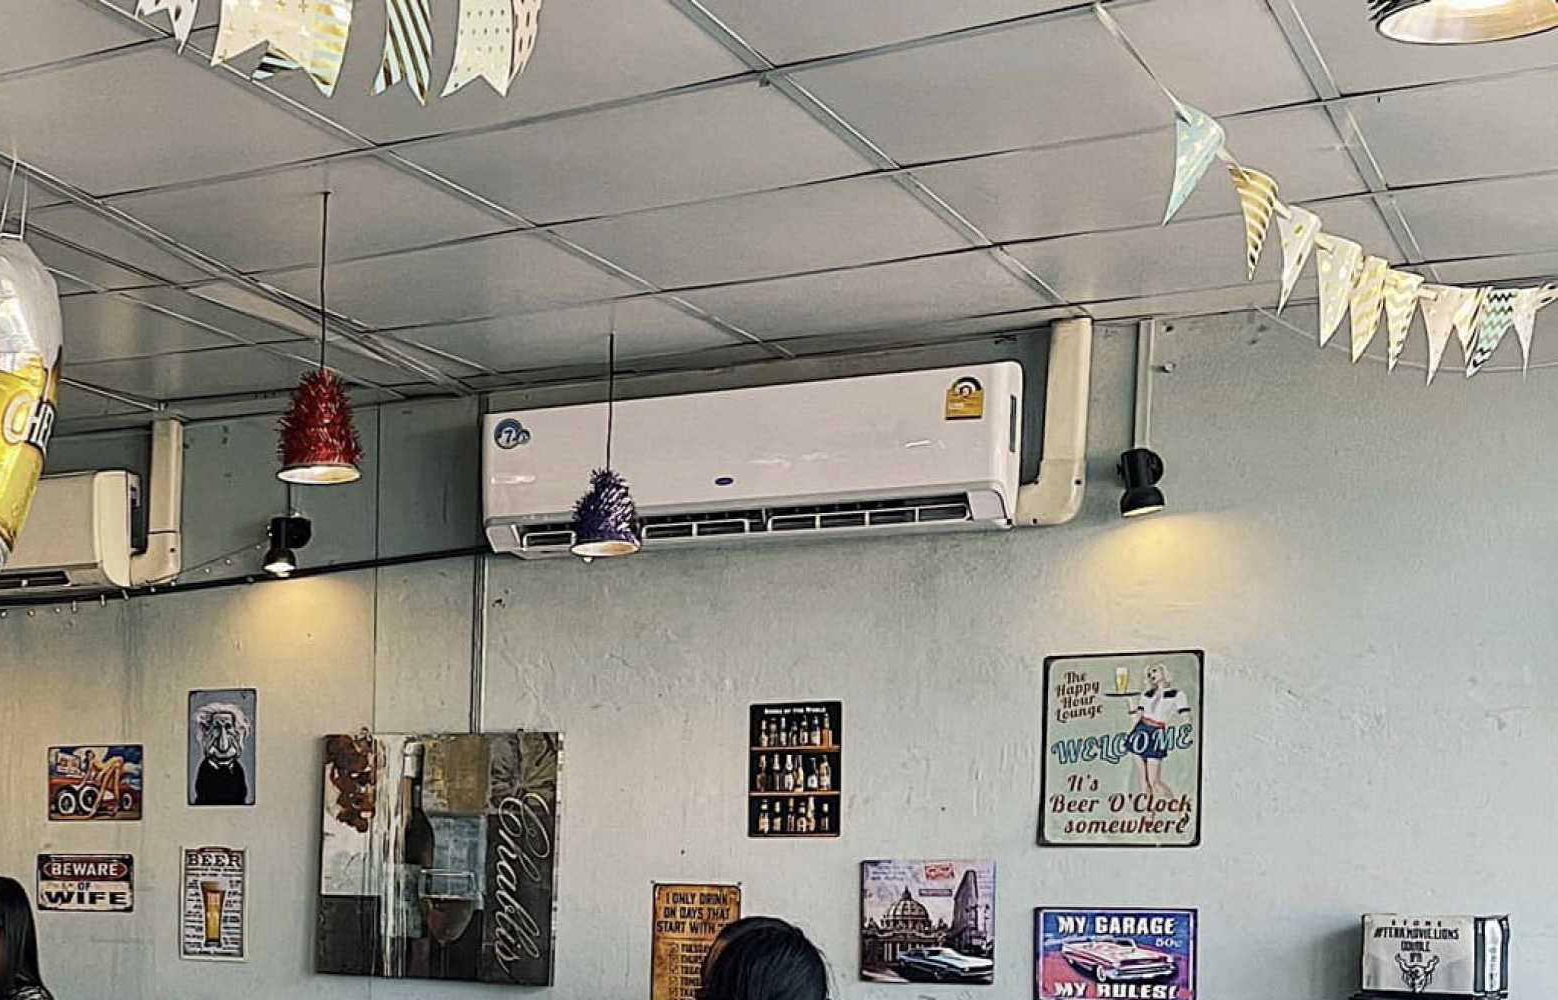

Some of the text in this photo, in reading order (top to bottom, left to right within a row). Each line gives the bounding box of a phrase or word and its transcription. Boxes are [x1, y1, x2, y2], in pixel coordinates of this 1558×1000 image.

[1065, 671, 1087, 682] The
[1056, 681, 1100, 697] Happy
[1063, 695, 1096, 709] Hour
[1056, 704, 1103, 723] Lounge
[1050, 723, 1194, 765] WELCOME
[1068, 774, 1098, 791] It's
[1050, 793, 1192, 814] Beer O'Clock
[1064, 813, 1191, 835] somewhere
[187, 853, 241, 867] BEER
[50, 862, 118, 876] BEWARE
[44, 891, 127, 904] WIFE
[672, 892, 696, 905] ONLY
[699, 893, 728, 905] DRINK
[664, 907, 730, 921] ON DAYS THAT
[656, 921, 715, 934] START WITH
[1057, 915, 1177, 935] MY GARAGE
[1400, 941, 1431, 952] DOUBLE
[1054, 982, 1180, 999] MY RULES!
